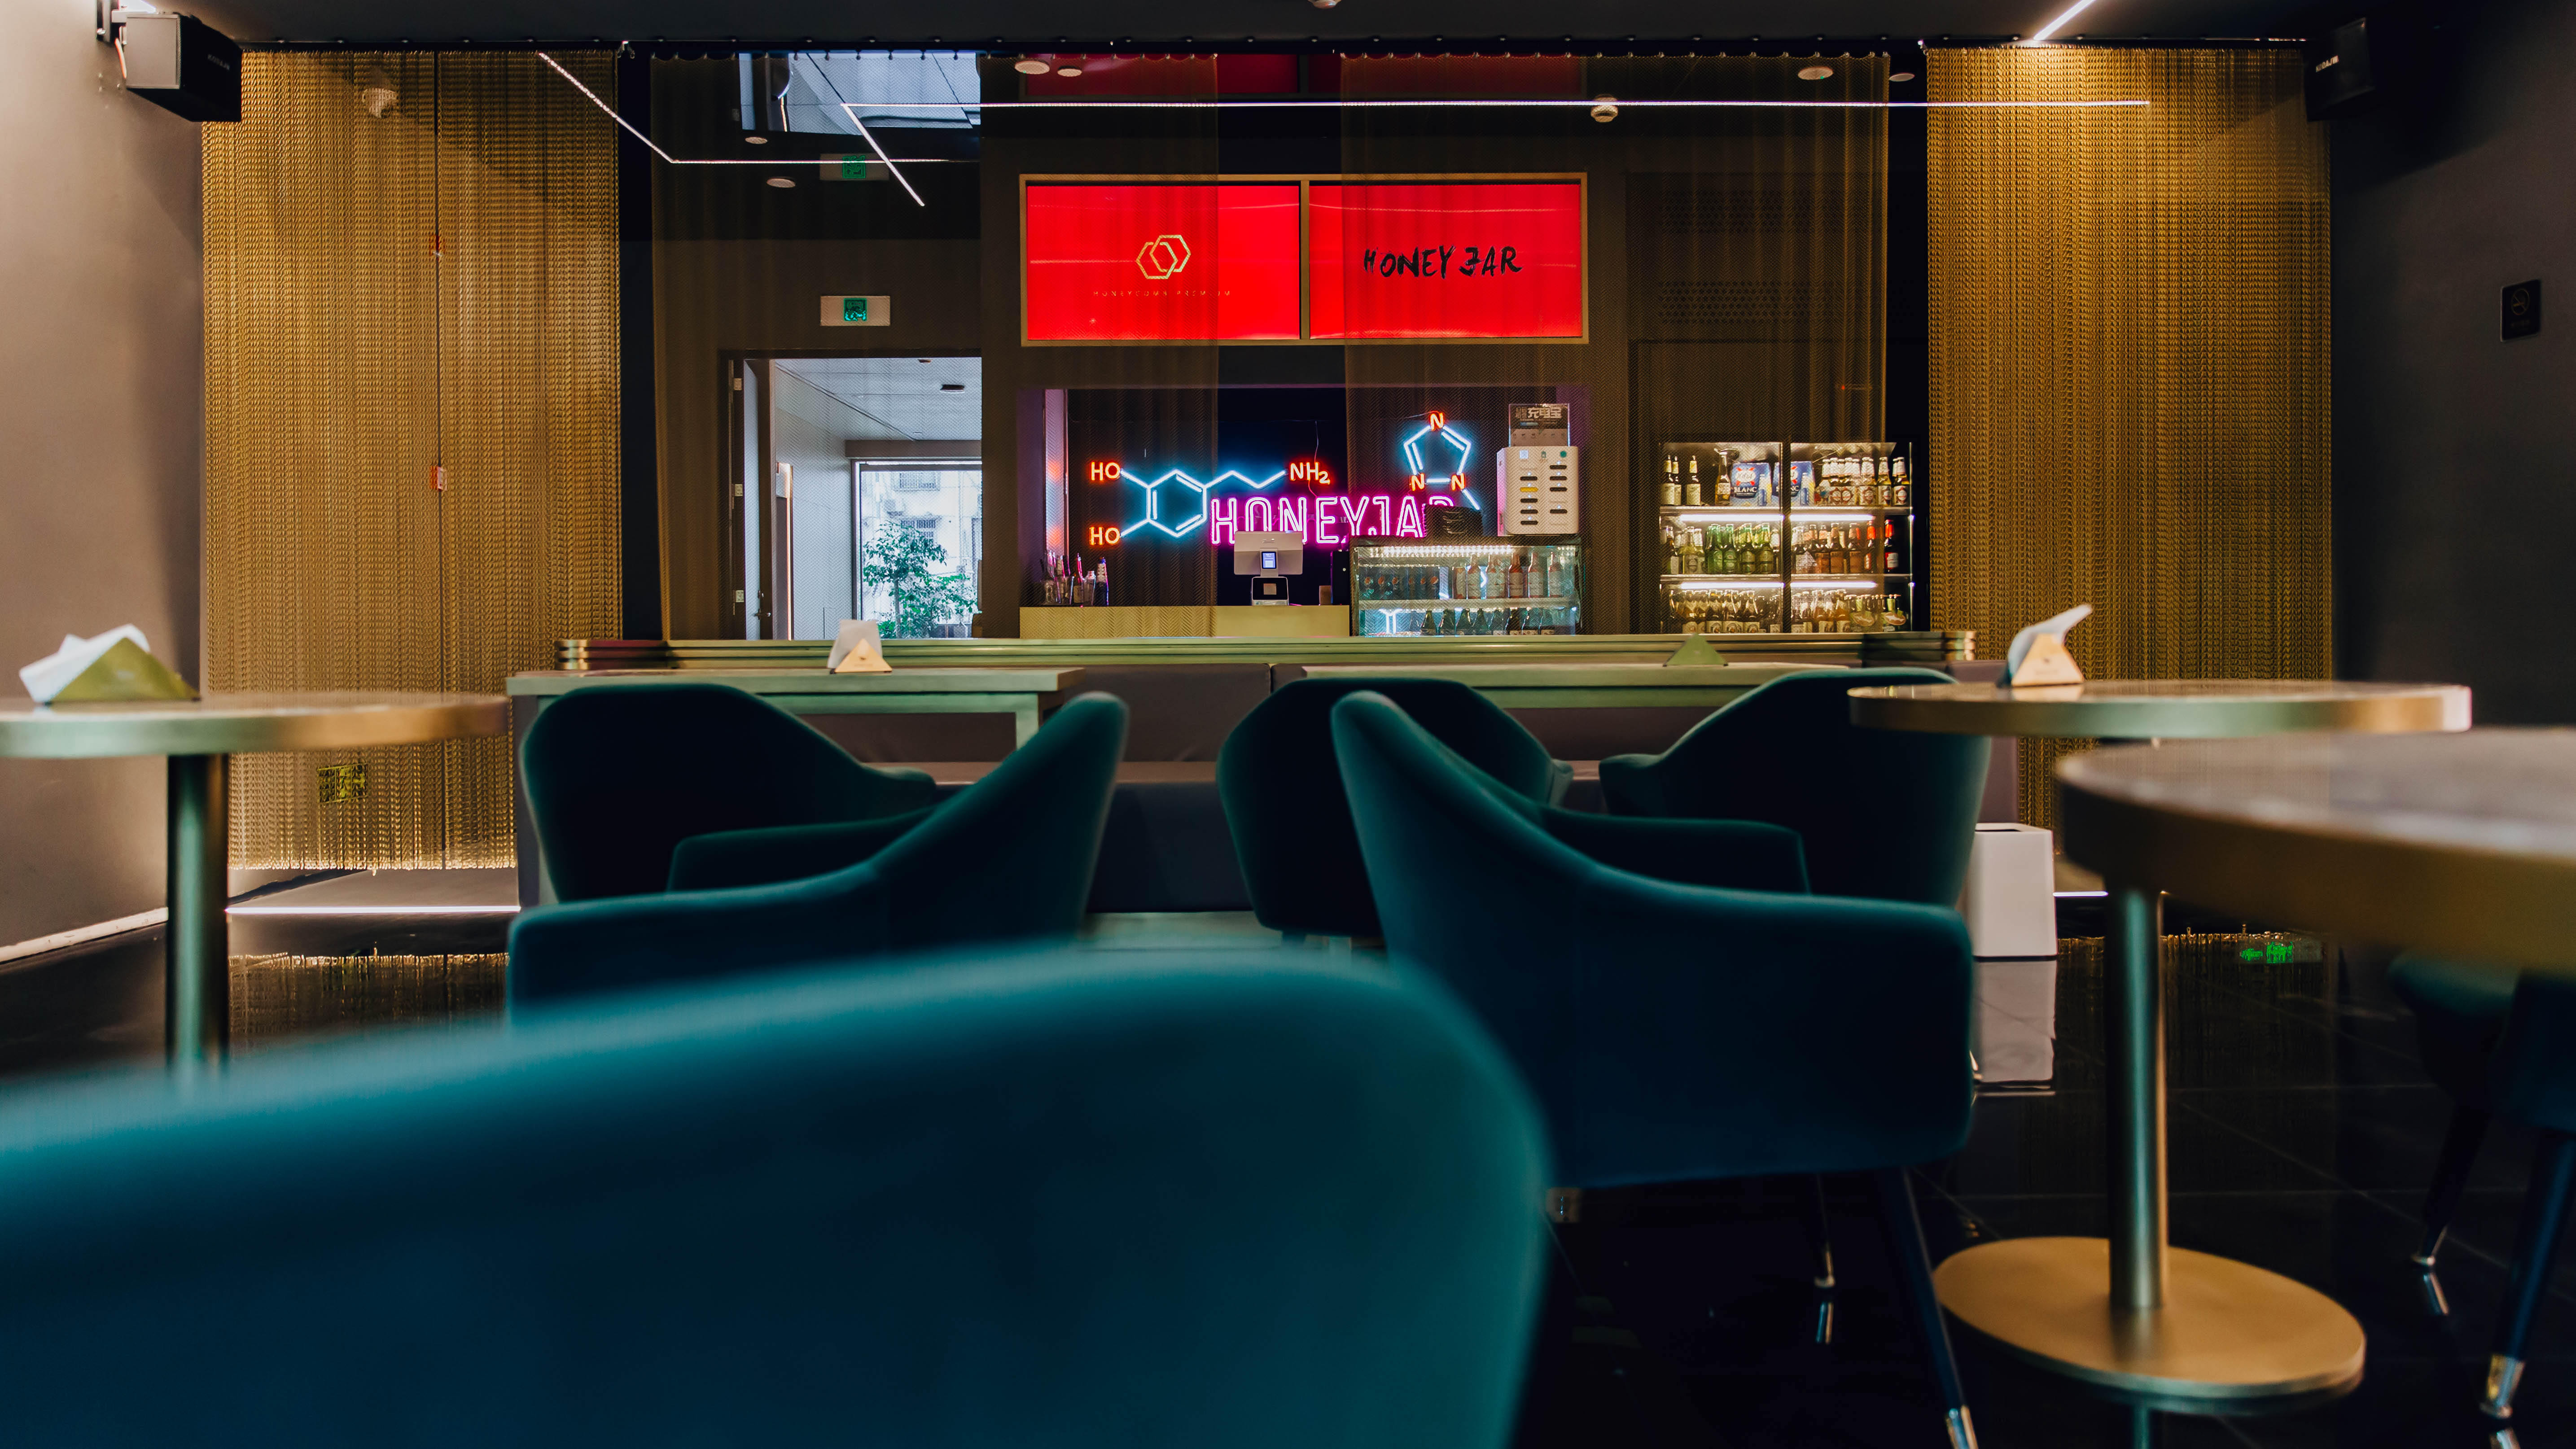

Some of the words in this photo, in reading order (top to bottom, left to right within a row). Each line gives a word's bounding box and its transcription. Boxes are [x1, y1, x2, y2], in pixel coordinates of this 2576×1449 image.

[1363, 245, 1457, 280] HONEY
[1459, 245, 1523, 277] JAR
[1430, 412, 1444, 431] N
[1091, 461, 1121, 481] HO
[1411, 473, 1425, 491] N
[1451, 473, 1465, 490] N
[1090, 526, 1120, 545] HO
